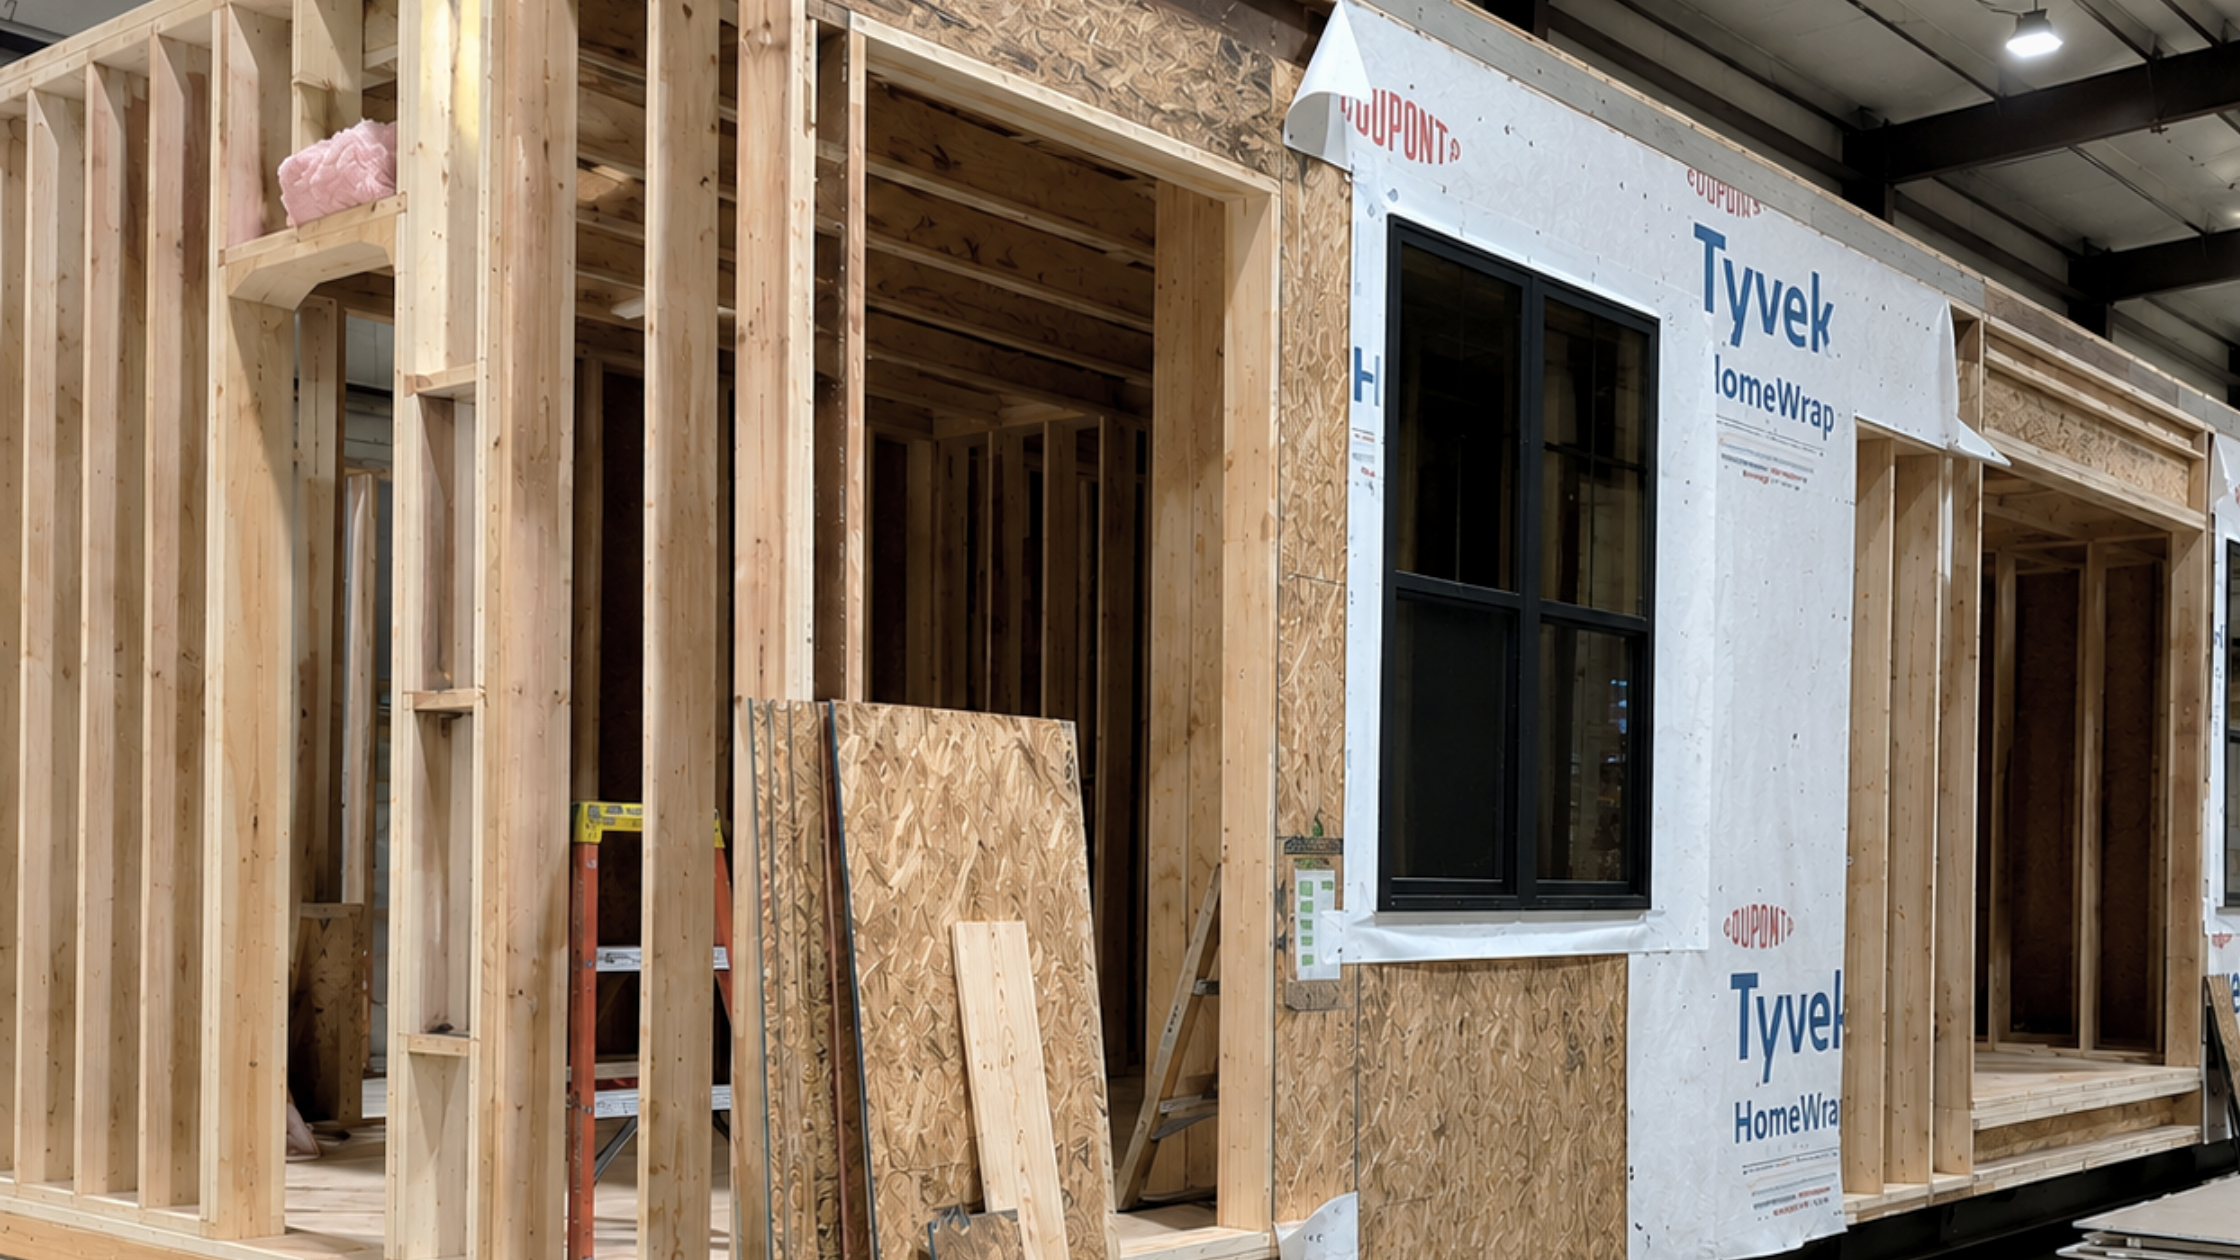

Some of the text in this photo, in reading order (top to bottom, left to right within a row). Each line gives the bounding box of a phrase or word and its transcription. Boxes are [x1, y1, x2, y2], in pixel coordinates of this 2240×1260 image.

[1694, 222, 1834, 353] Tyvek
[1732, 903, 1786, 950] DUPONT
[1730, 969, 1844, 1084] Tyvek
[1734, 1092, 1839, 1144] HomeWra
